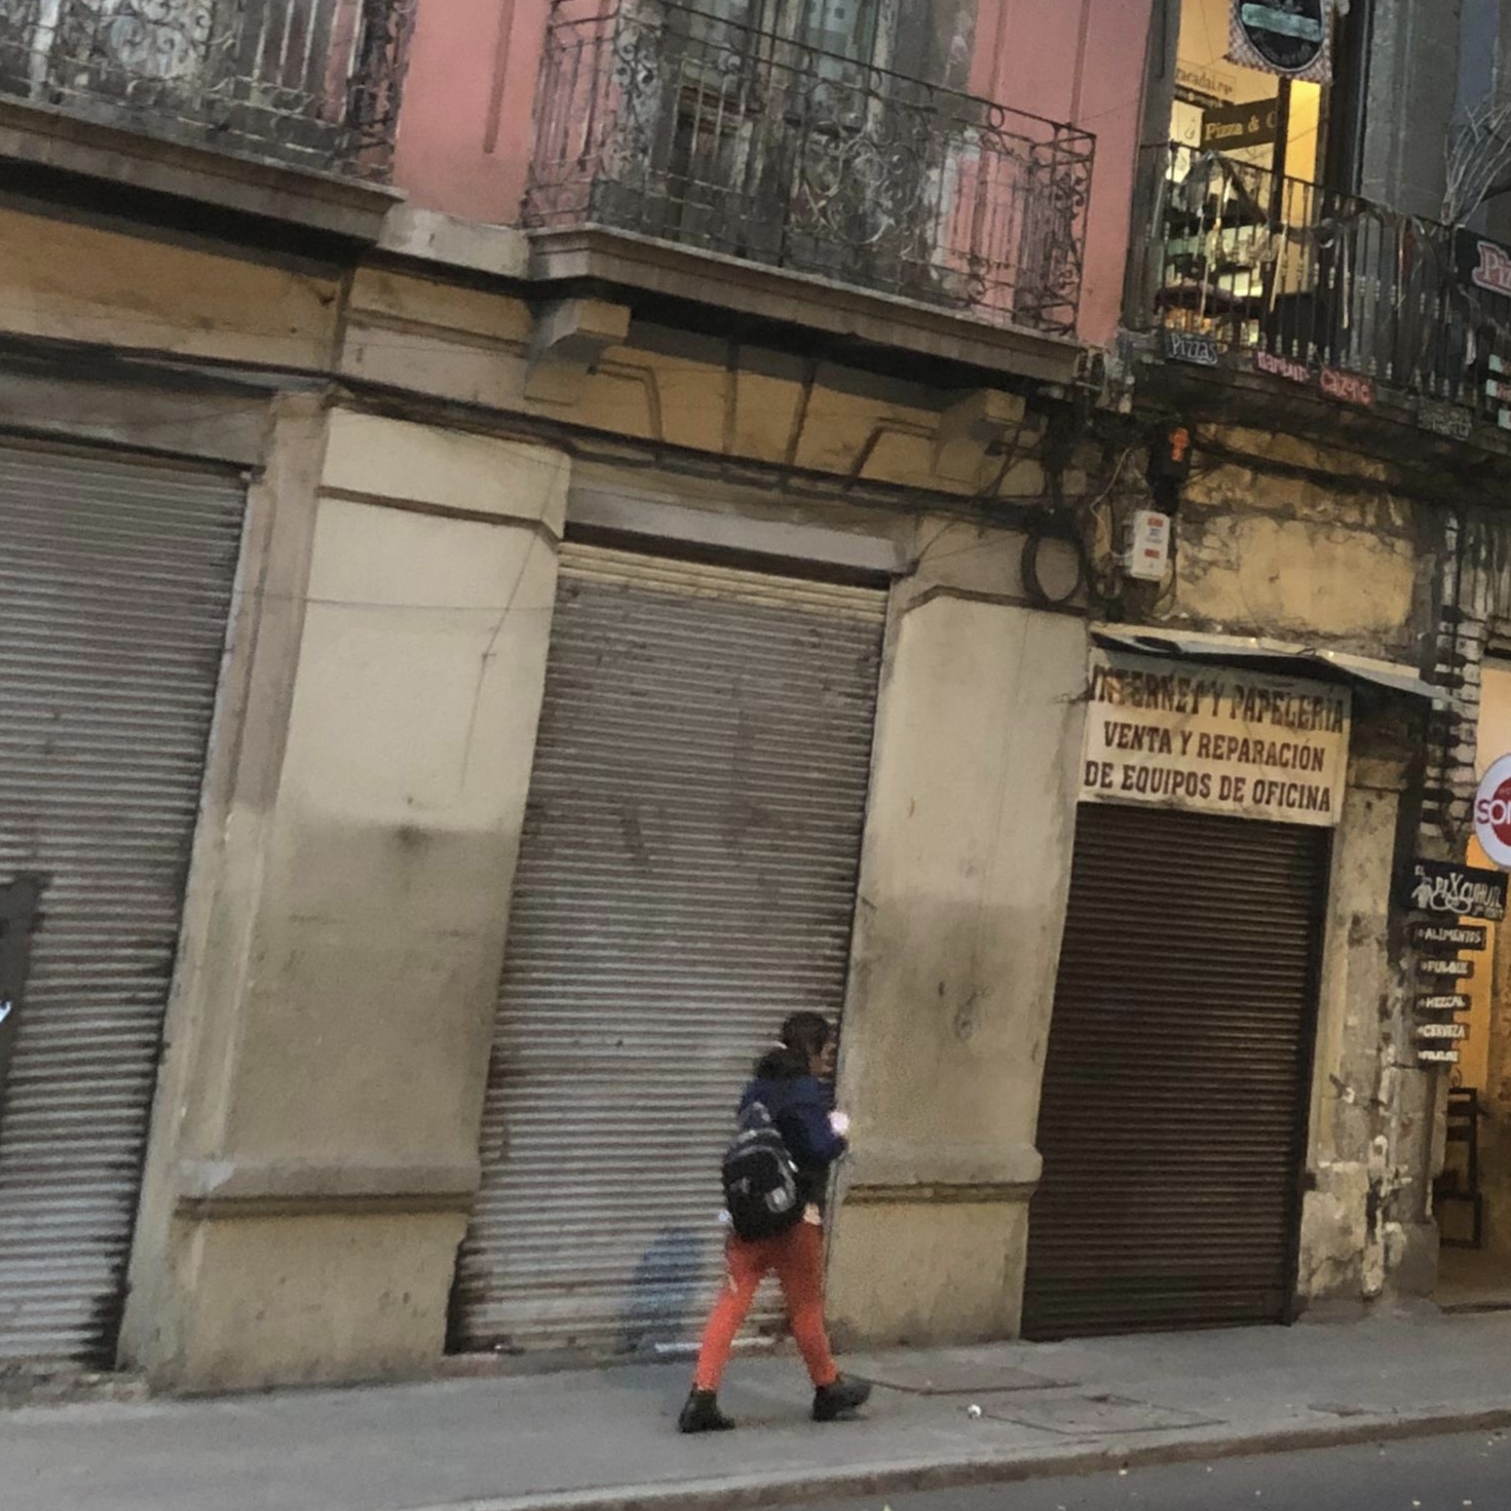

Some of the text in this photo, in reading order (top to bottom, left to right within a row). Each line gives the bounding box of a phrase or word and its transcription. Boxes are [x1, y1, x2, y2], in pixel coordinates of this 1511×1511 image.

[1104, 721, 1325, 772] VENTA Y REPARACIÓN
[1084, 760, 1331, 812] DE EQUIPOS DE OFICINA
